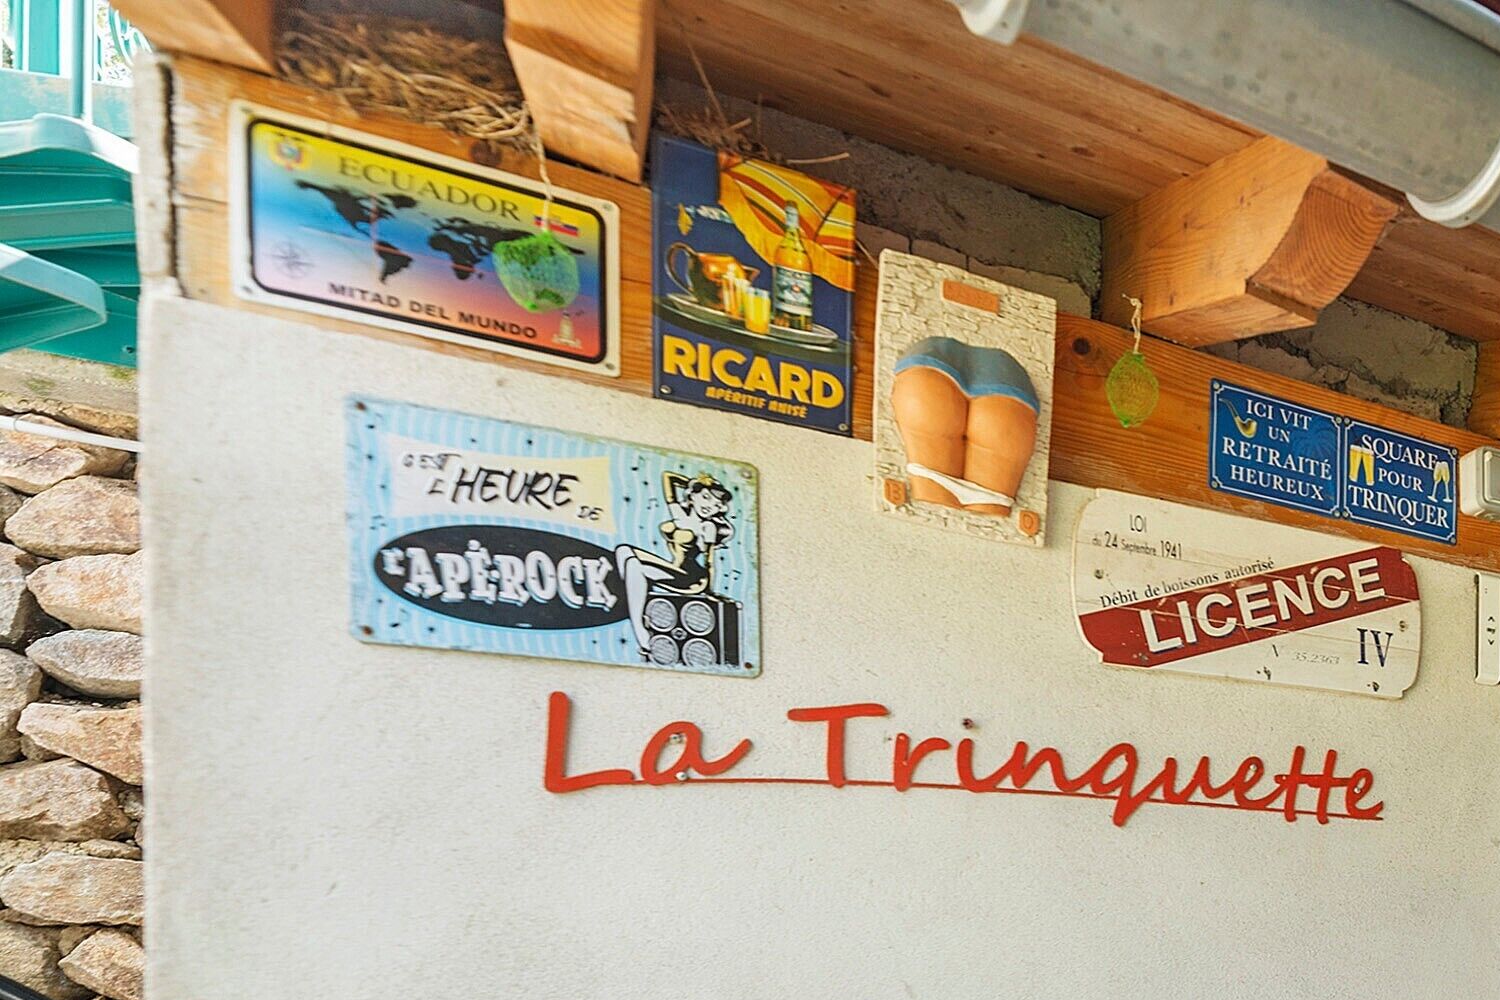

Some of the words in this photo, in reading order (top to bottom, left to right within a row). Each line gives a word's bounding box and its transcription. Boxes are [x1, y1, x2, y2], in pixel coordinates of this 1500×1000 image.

[338, 155, 521, 222] ECUADOR
[328, 281, 400, 308] MITAD
[409, 301, 449, 321] DEL
[458, 311, 538, 340] MUNDO
[663, 334, 845, 409] RICARD
[1246, 399, 1273, 421] ICI
[1278, 408, 1312, 431] VIT
[1268, 426, 1290, 443] UN
[1222, 436, 1332, 480] RETRAITÉ
[1362, 434, 1438, 470] SQUARE
[1230, 464, 1325, 501] HEUREUX
[1378, 467, 1424, 493] POUR
[578, 505, 604, 521] DE
[1129, 514, 1147, 533] LOI
[1348, 485, 1449, 529] TRINQUER
[1104, 530, 1118, 548] 24
[1160, 540, 1182, 560] 1941
[1100, 590, 1138, 608] Débit
[1144, 584, 1160, 599] de
[1163, 573, 1219, 594] boissons
[1224, 557, 1274, 580] autorisé
[1139, 557, 1386, 654] LICENCE
[1357, 627, 1394, 668] IV
[544, 689, 752, 794] La
[786, 702, 1385, 827] Trinquette
